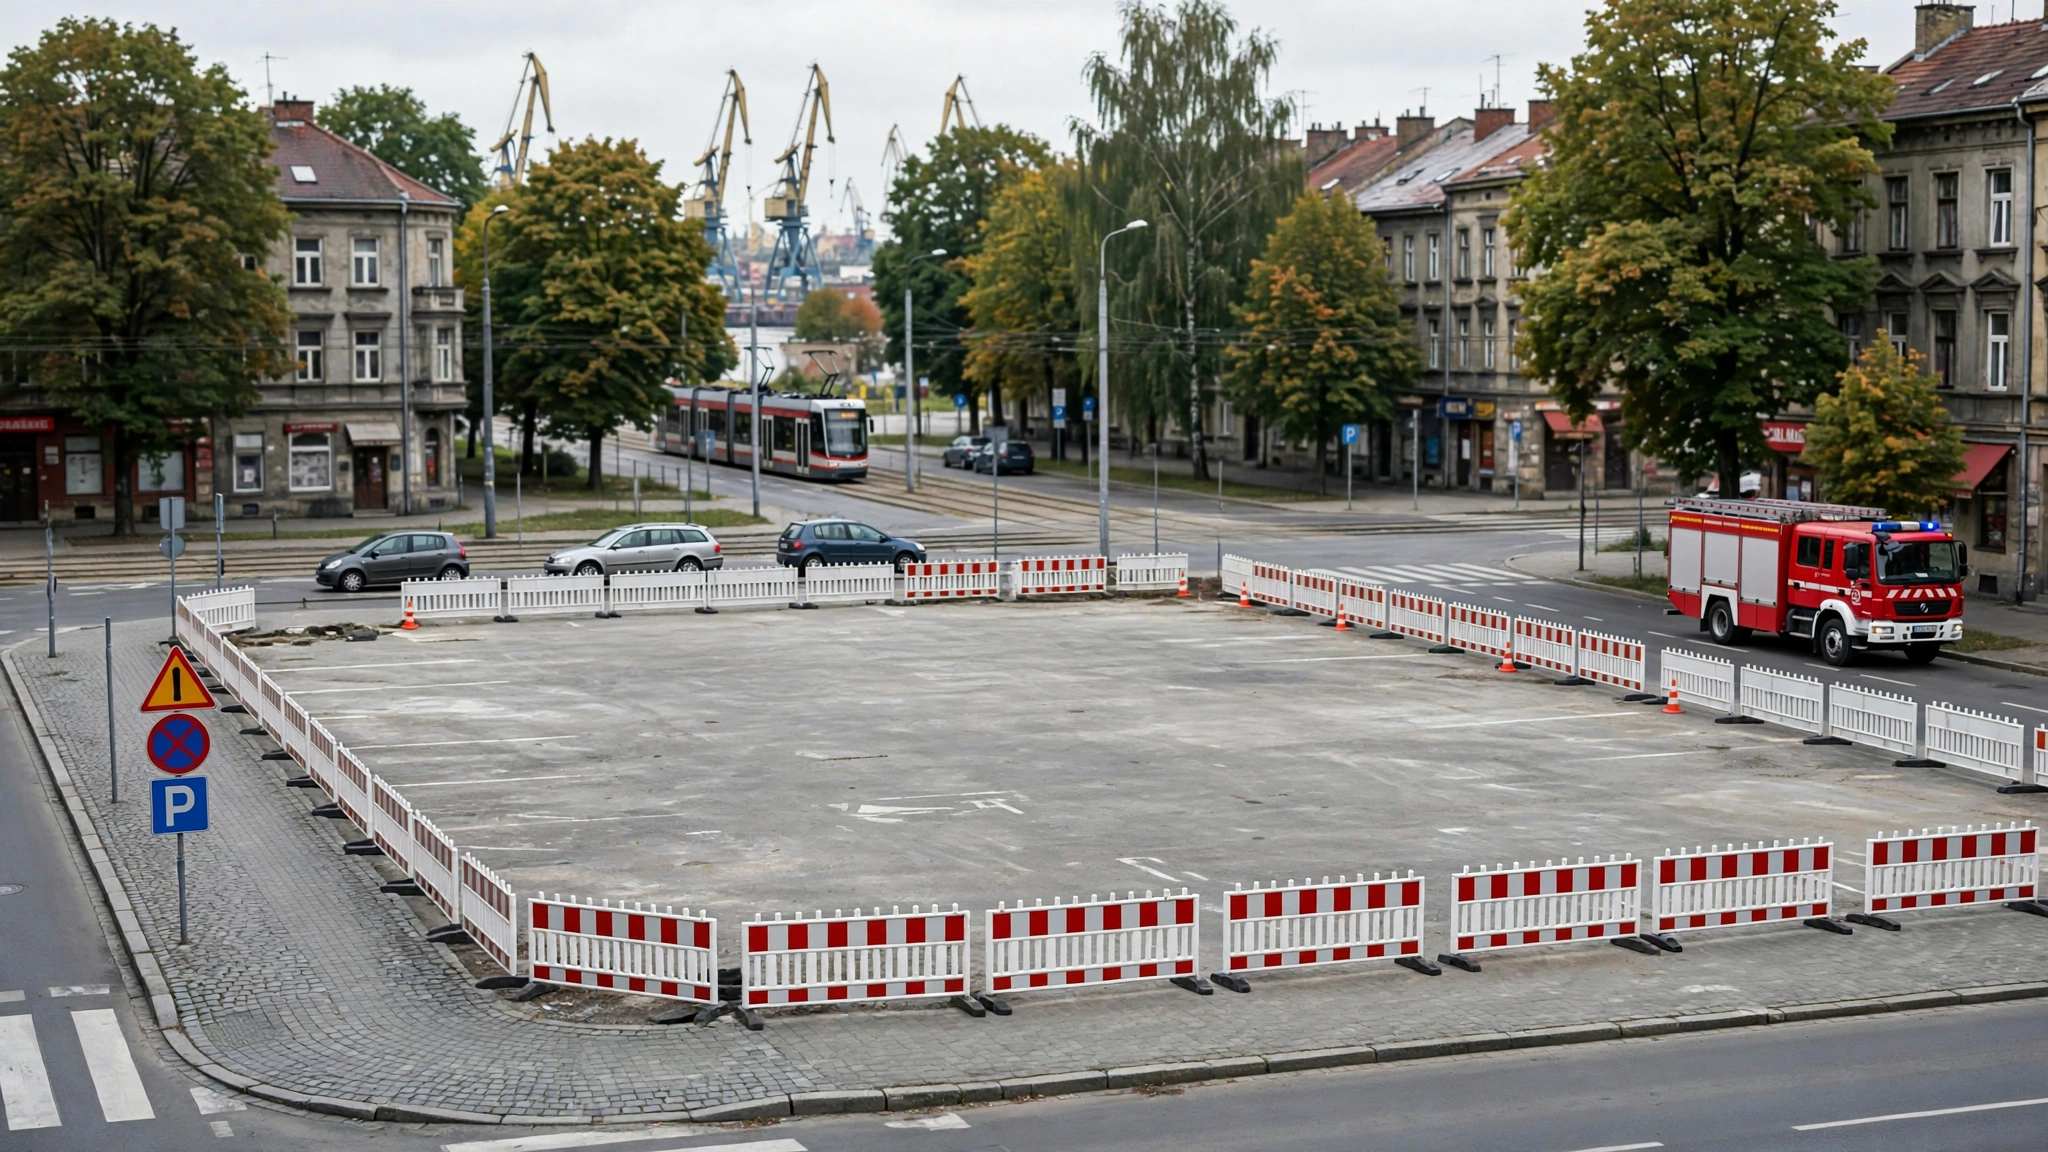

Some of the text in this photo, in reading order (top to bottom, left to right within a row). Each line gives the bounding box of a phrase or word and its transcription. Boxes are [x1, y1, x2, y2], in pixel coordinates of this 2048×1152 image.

[1346, 427, 1356, 442] P
[1513, 421, 1521, 437] P
[165, 785, 195, 827] P
